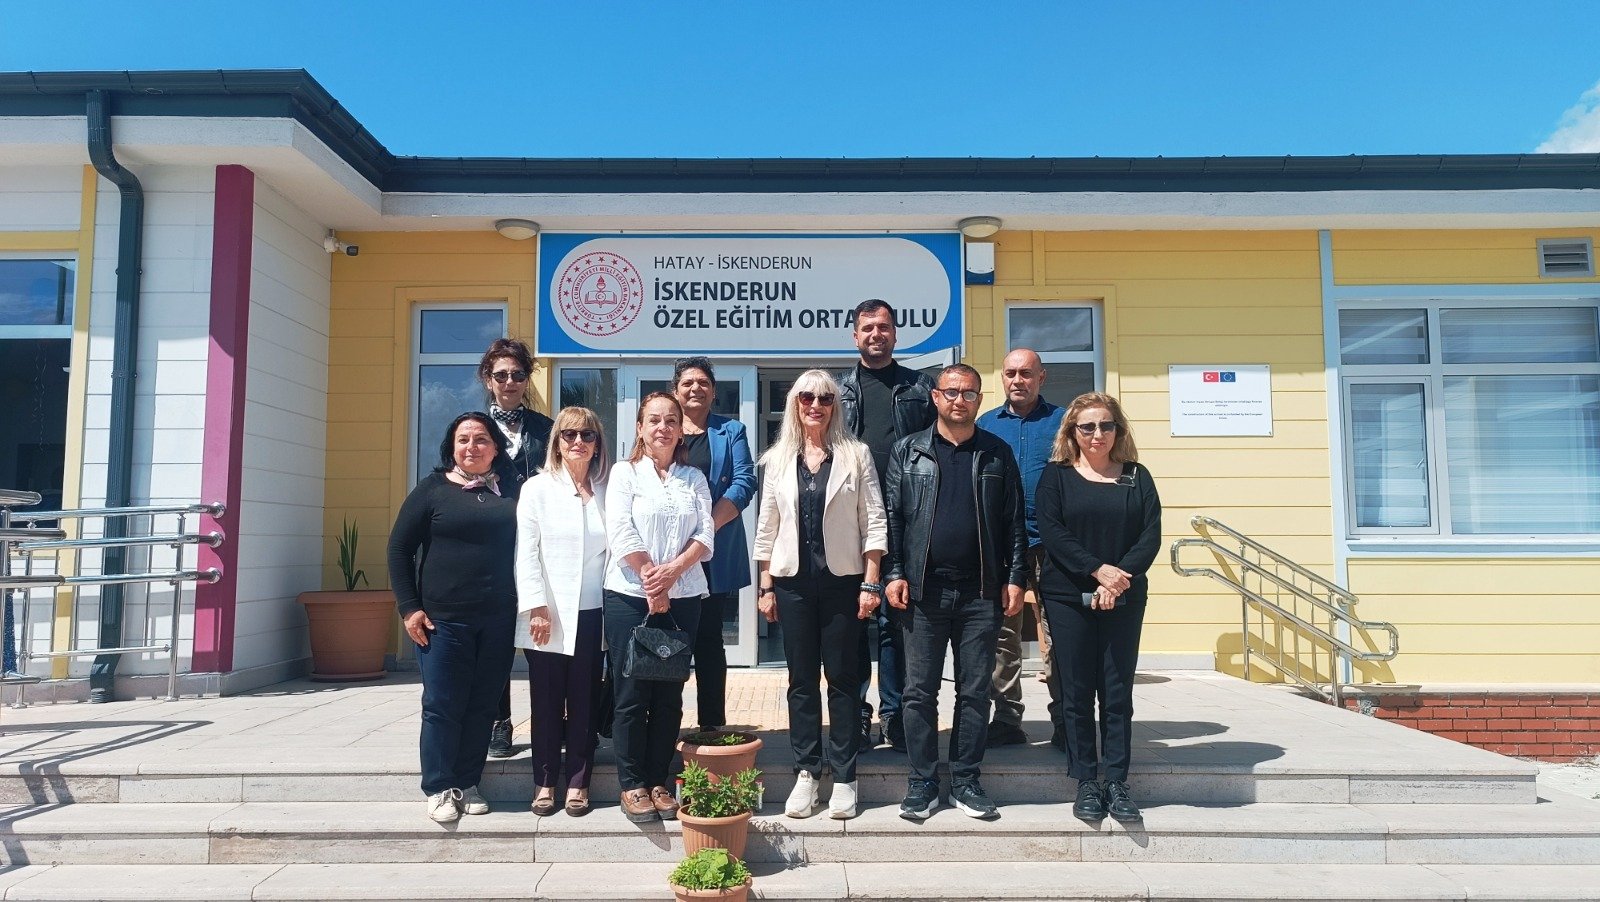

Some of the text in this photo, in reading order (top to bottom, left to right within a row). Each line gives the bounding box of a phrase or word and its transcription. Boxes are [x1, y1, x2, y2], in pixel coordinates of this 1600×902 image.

[654, 256, 705, 270] HATAY
[717, 254, 812, 270] İSKENDERUN
[654, 277, 797, 301] İSKENDERUN
[653, 304, 938, 329] ÖZEL EĞİTİM ORTAULU
